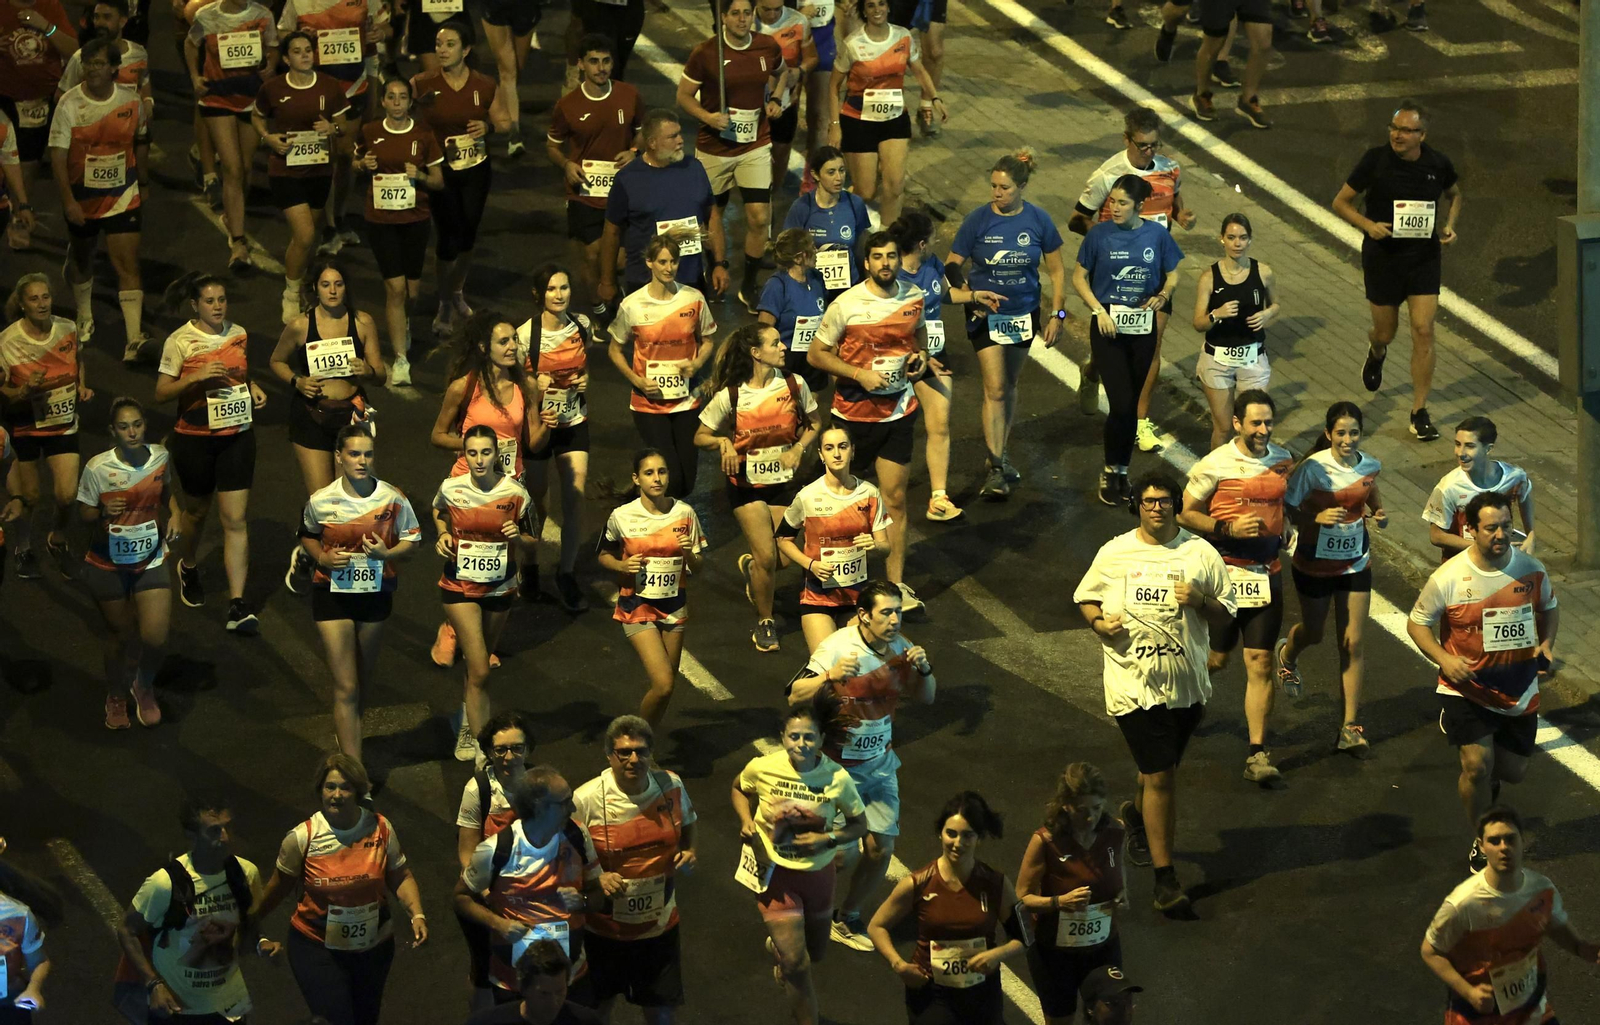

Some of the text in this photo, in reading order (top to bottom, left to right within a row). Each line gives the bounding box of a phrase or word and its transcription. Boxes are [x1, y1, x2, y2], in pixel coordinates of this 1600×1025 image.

[227, 45, 253, 57] 6502
[323, 42, 355, 55] 23765
[730, 122, 753, 134] 2663
[294, 143, 320, 156] 2658
[93, 167, 119, 180] 6268
[590, 175, 615, 187] 2665
[381, 188, 407, 200] 2672
[1399, 216, 1429, 228] 14081
[818, 266, 843, 279] 5517
[1115, 312, 1147, 325] 10671
[994, 319, 1026, 335] 10667
[928, 336, 940, 348] 70
[1223, 345, 1251, 358] 3697
[313, 353, 350, 369] 11931
[213, 400, 246, 418] 15569
[752, 461, 781, 475] 1948
[115, 538, 152, 554] 13278
[1327, 536, 1356, 550] 6163
[463, 557, 501, 571] 21659
[835, 558, 862, 576] 1657
[336, 568, 376, 583] 21868
[641, 573, 676, 587] 24199
[1136, 587, 1168, 602] 6647
[1493, 622, 1525, 639] 7668
[1135, 643, 1186, 660] ワンピース
[855, 734, 884, 750] 4095
[314, 873, 370, 887] 37 NOCTURNA
[628, 895, 653, 912] 902
[342, 922, 367, 939] 925
[1069, 920, 1102, 936] 2683
[942, 959, 969, 976] 268
